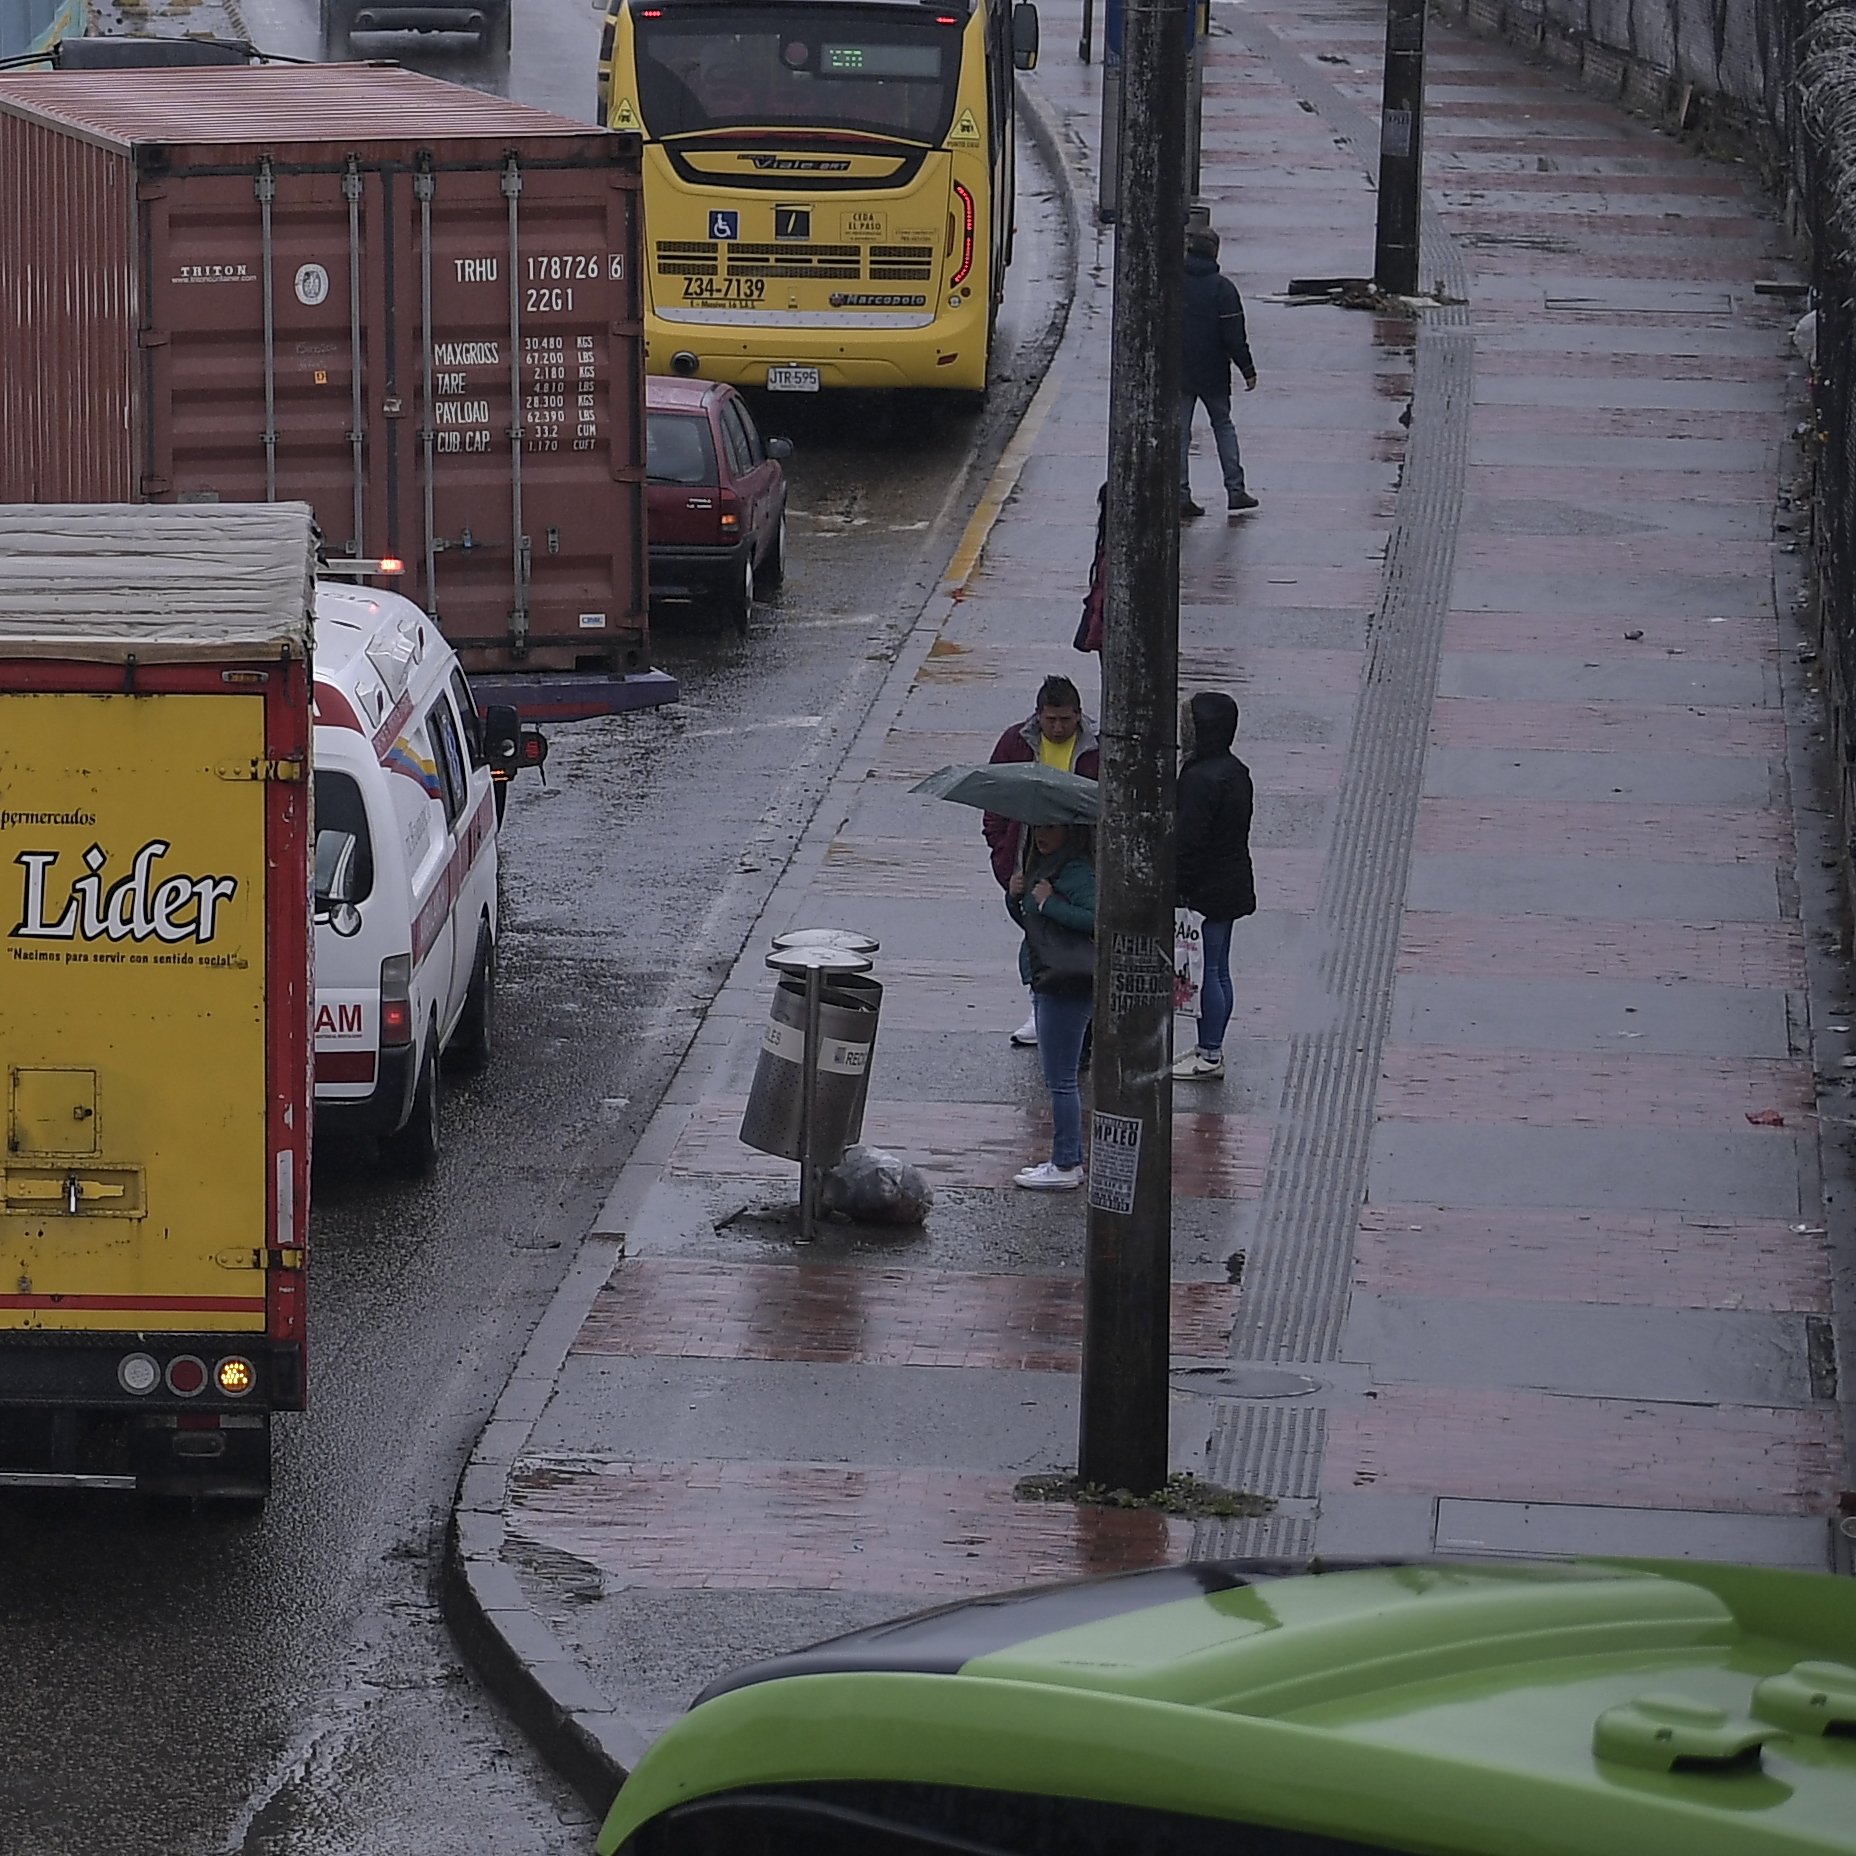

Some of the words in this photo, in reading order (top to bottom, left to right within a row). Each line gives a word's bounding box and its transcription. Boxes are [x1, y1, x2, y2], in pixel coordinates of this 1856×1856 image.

[180, 265, 247, 277] TRITON
[454, 258, 498, 282] TRHU
[527, 255, 599, 280] 178726
[683, 276, 766, 299] Z34-7139
[526, 288, 574, 312] 22G1
[846, 294, 925, 306] Marcopolo
[525, 337, 563, 349] 30.480
[577, 336, 593, 348] KGS
[434, 343, 499, 366] MAXGROSS
[526, 352, 564, 364] 67.200
[578, 352, 594, 363] LBS
[534, 367, 565, 379] 2.180
[579, 366, 595, 378] KGS
[436, 373, 467, 394] TARE
[533, 382, 564, 394] 4.810
[578, 381, 595, 392] LBS
[526, 396, 564, 408] 28.300
[578, 395, 594, 406] KGS
[435, 401, 489, 424] PAYLOAD
[527, 411, 565, 423] 62.390
[579, 410, 595, 421] LBS
[535, 425, 559, 438] 33.2
[577, 424, 597, 437] CUM
[573, 439, 596, 450] CUFT
[7, 839, 239, 945] Lider
[65, 952, 89, 965] para
[93, 950, 126, 964] servir
[129, 953, 149, 964] con
[153, 952, 194, 965] sentido
